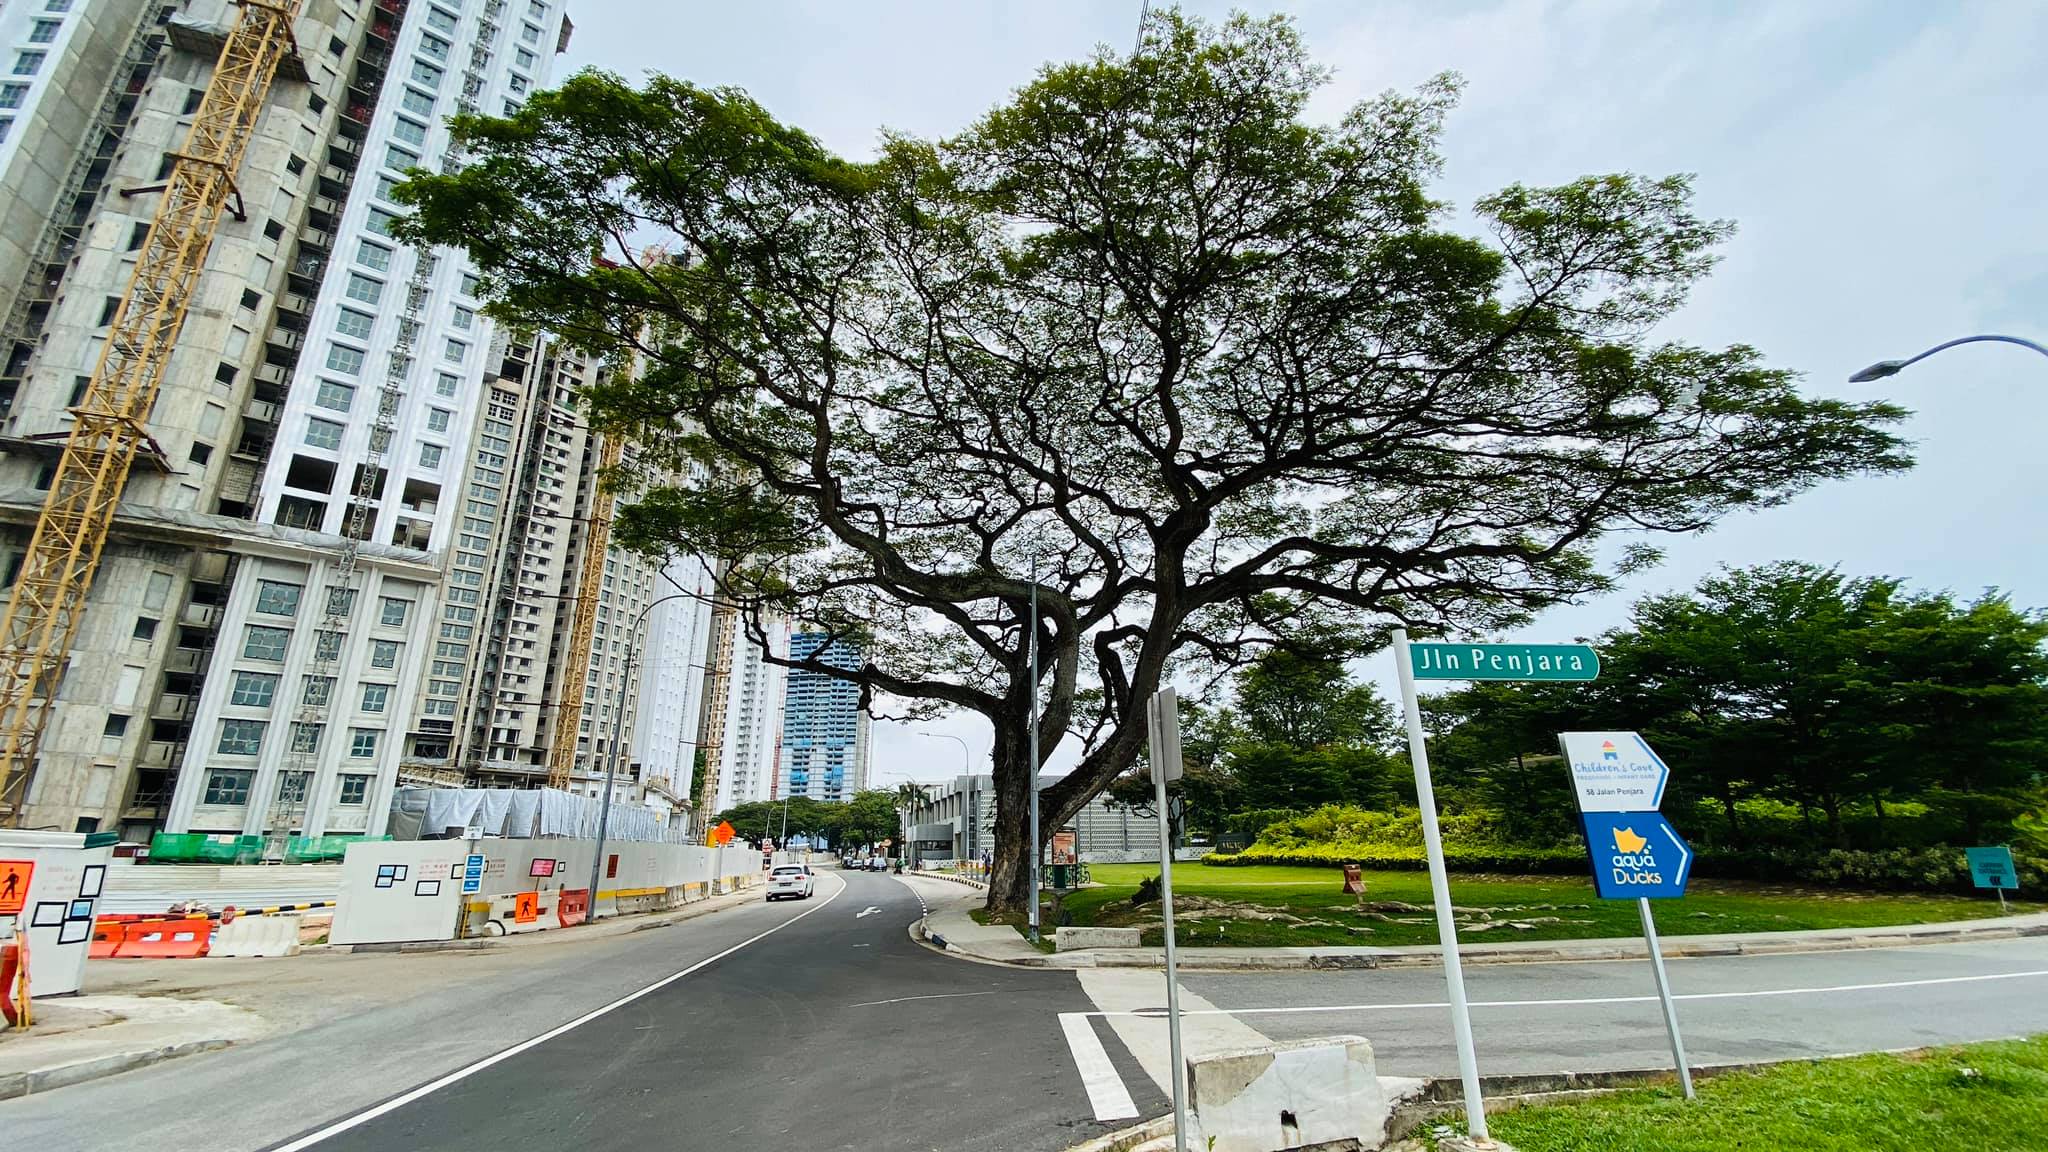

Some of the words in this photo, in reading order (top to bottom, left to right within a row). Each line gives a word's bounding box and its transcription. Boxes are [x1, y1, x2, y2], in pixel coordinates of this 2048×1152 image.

[1420, 648, 1460, 670] Jln
[1471, 648, 1583, 676] Penjara
[1597, 788, 1616, 796] Jalan
[1616, 788, 1645, 797] Penjara
[1612, 855, 1657, 871] aqua
[1613, 868, 1663, 885] Ducks
